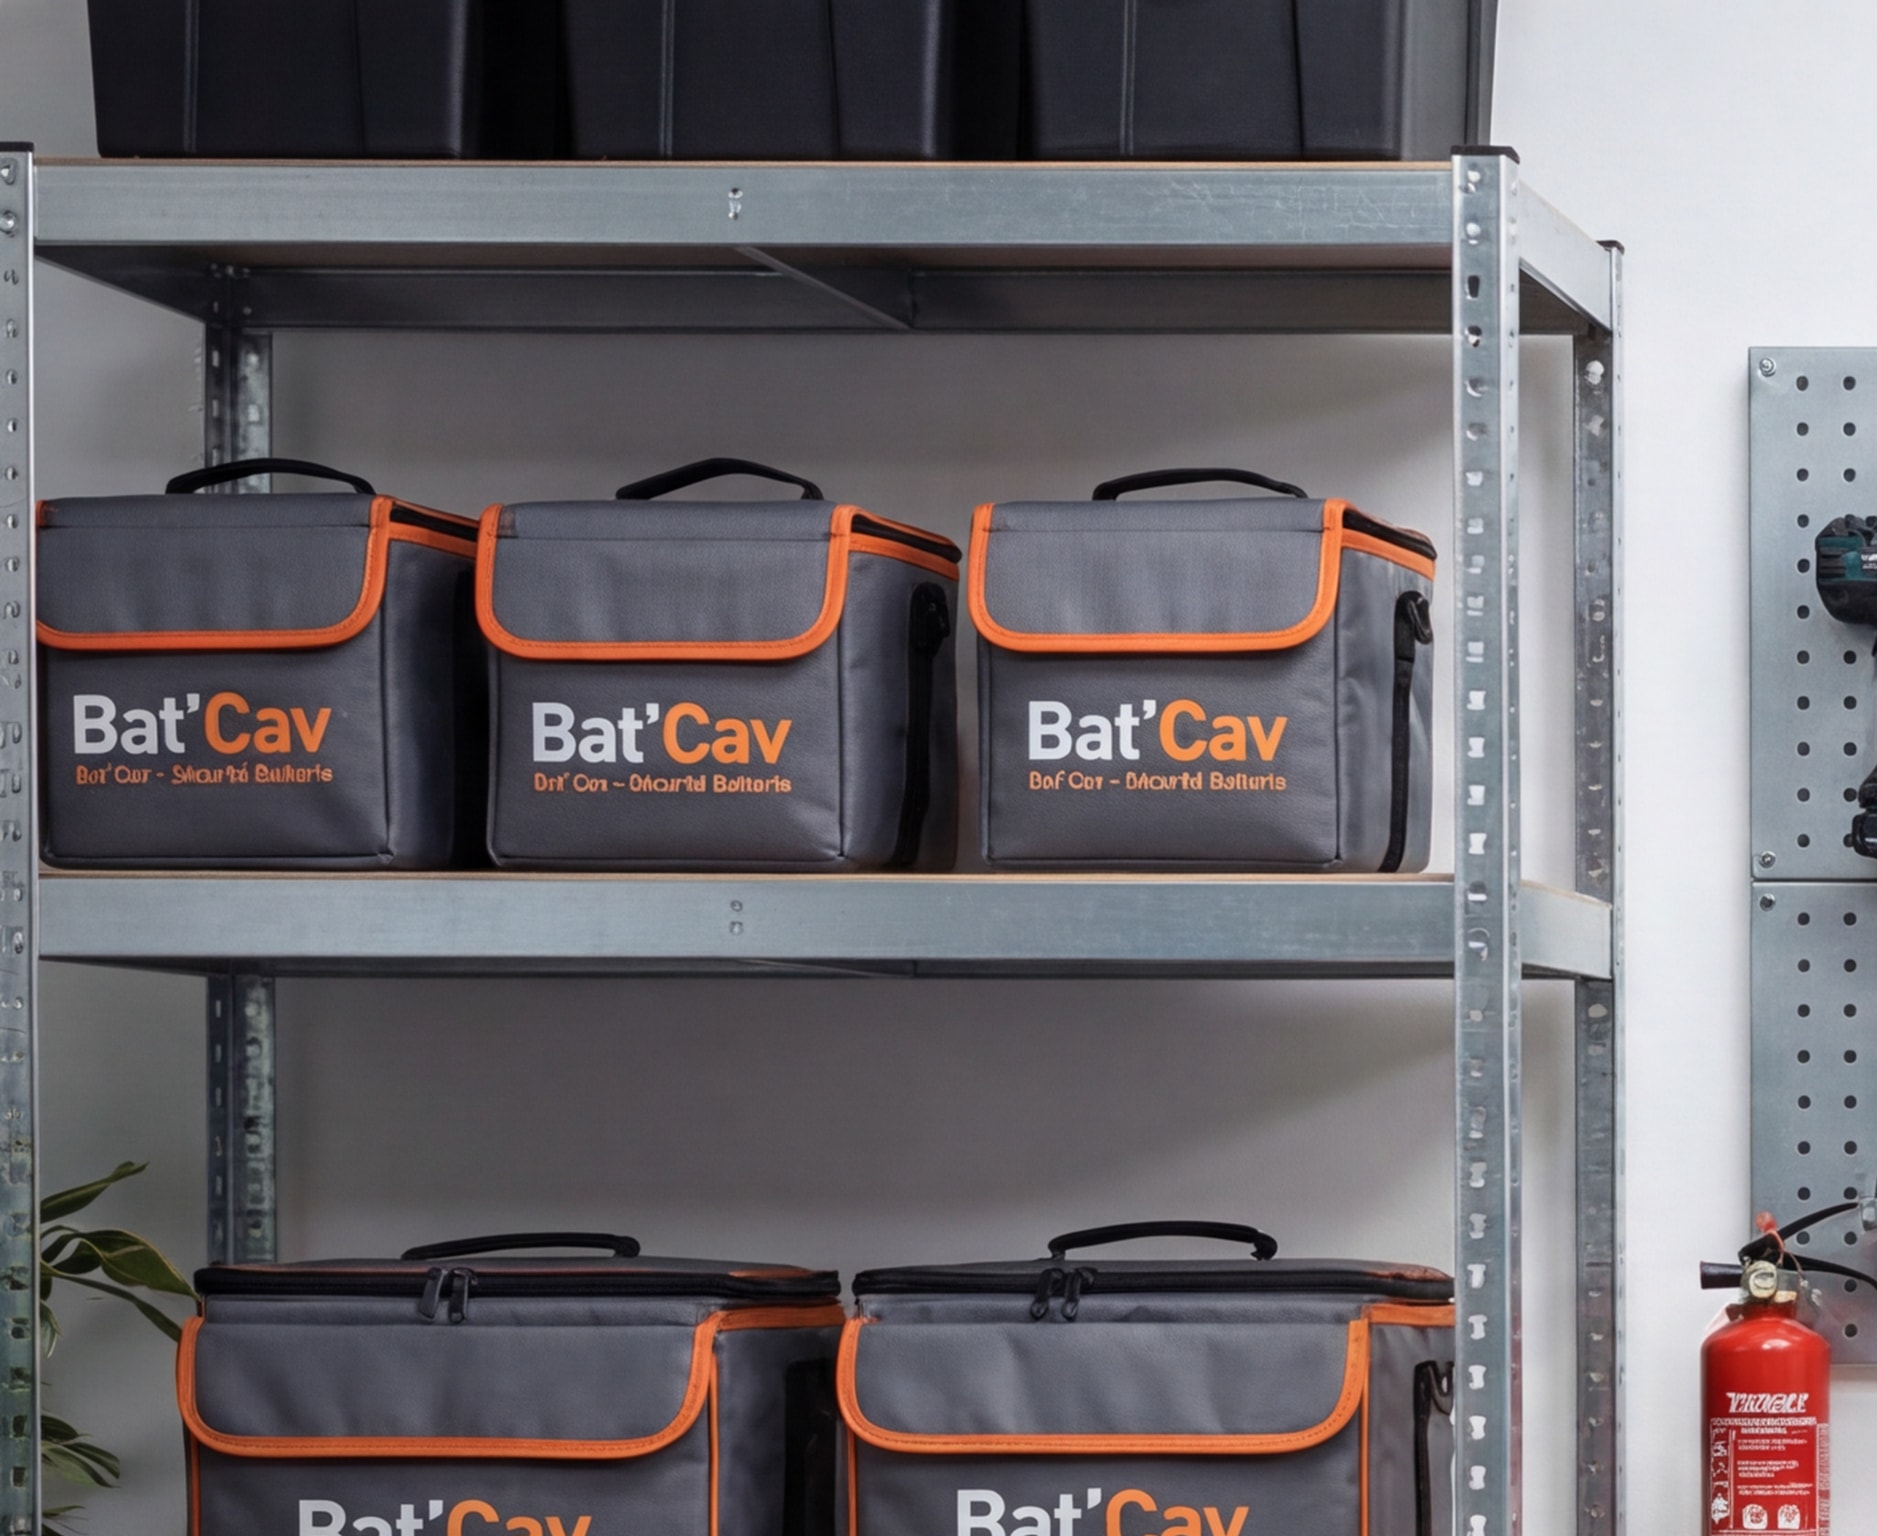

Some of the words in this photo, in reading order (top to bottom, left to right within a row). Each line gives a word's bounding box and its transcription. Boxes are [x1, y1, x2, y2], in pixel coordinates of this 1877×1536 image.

[73, 692, 331, 754] Bat'Cav
[534, 702, 792, 764] Bat'Cav
[1029, 699, 1287, 762] Bat'Cav
